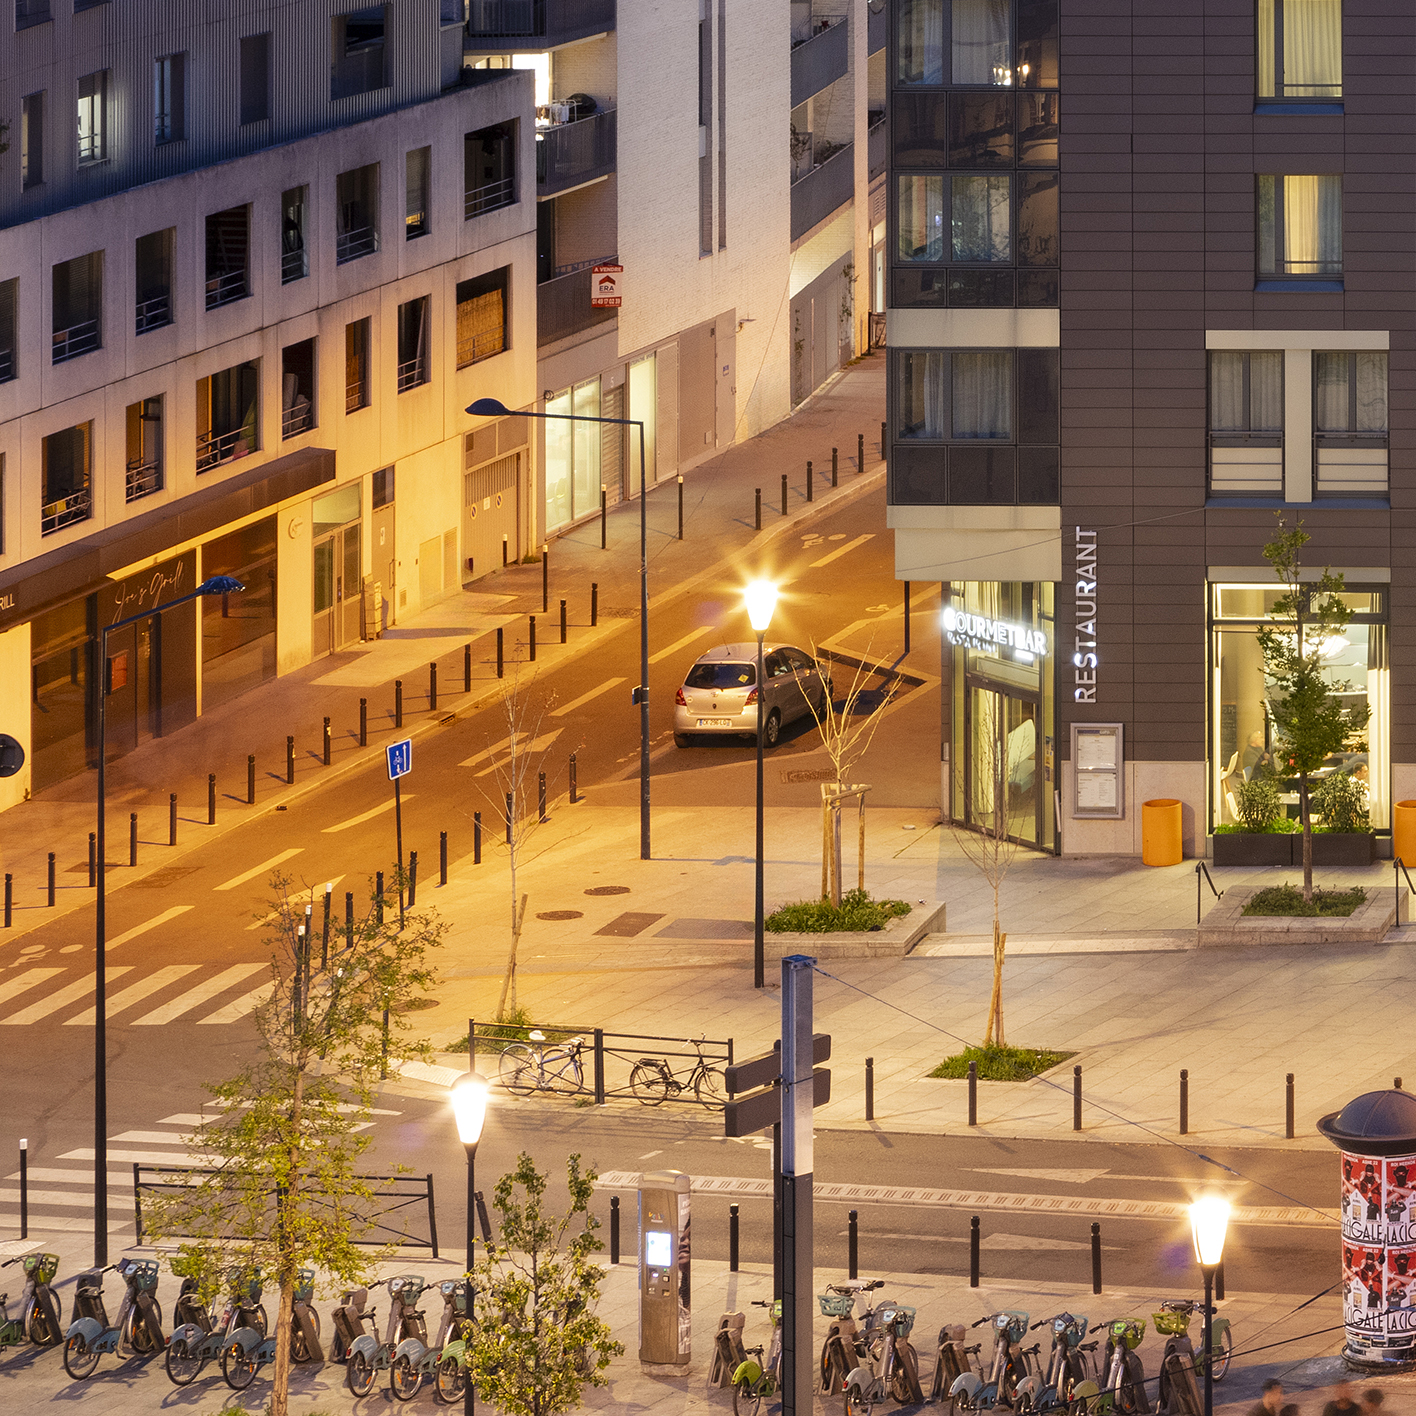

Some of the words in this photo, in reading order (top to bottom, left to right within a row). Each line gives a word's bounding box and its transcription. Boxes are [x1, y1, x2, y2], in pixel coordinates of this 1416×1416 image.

[1074, 526, 1098, 703] RESTAURANT
[1387, 1226, 1398, 1243] LA
[1387, 1312, 1397, 1329] LA
